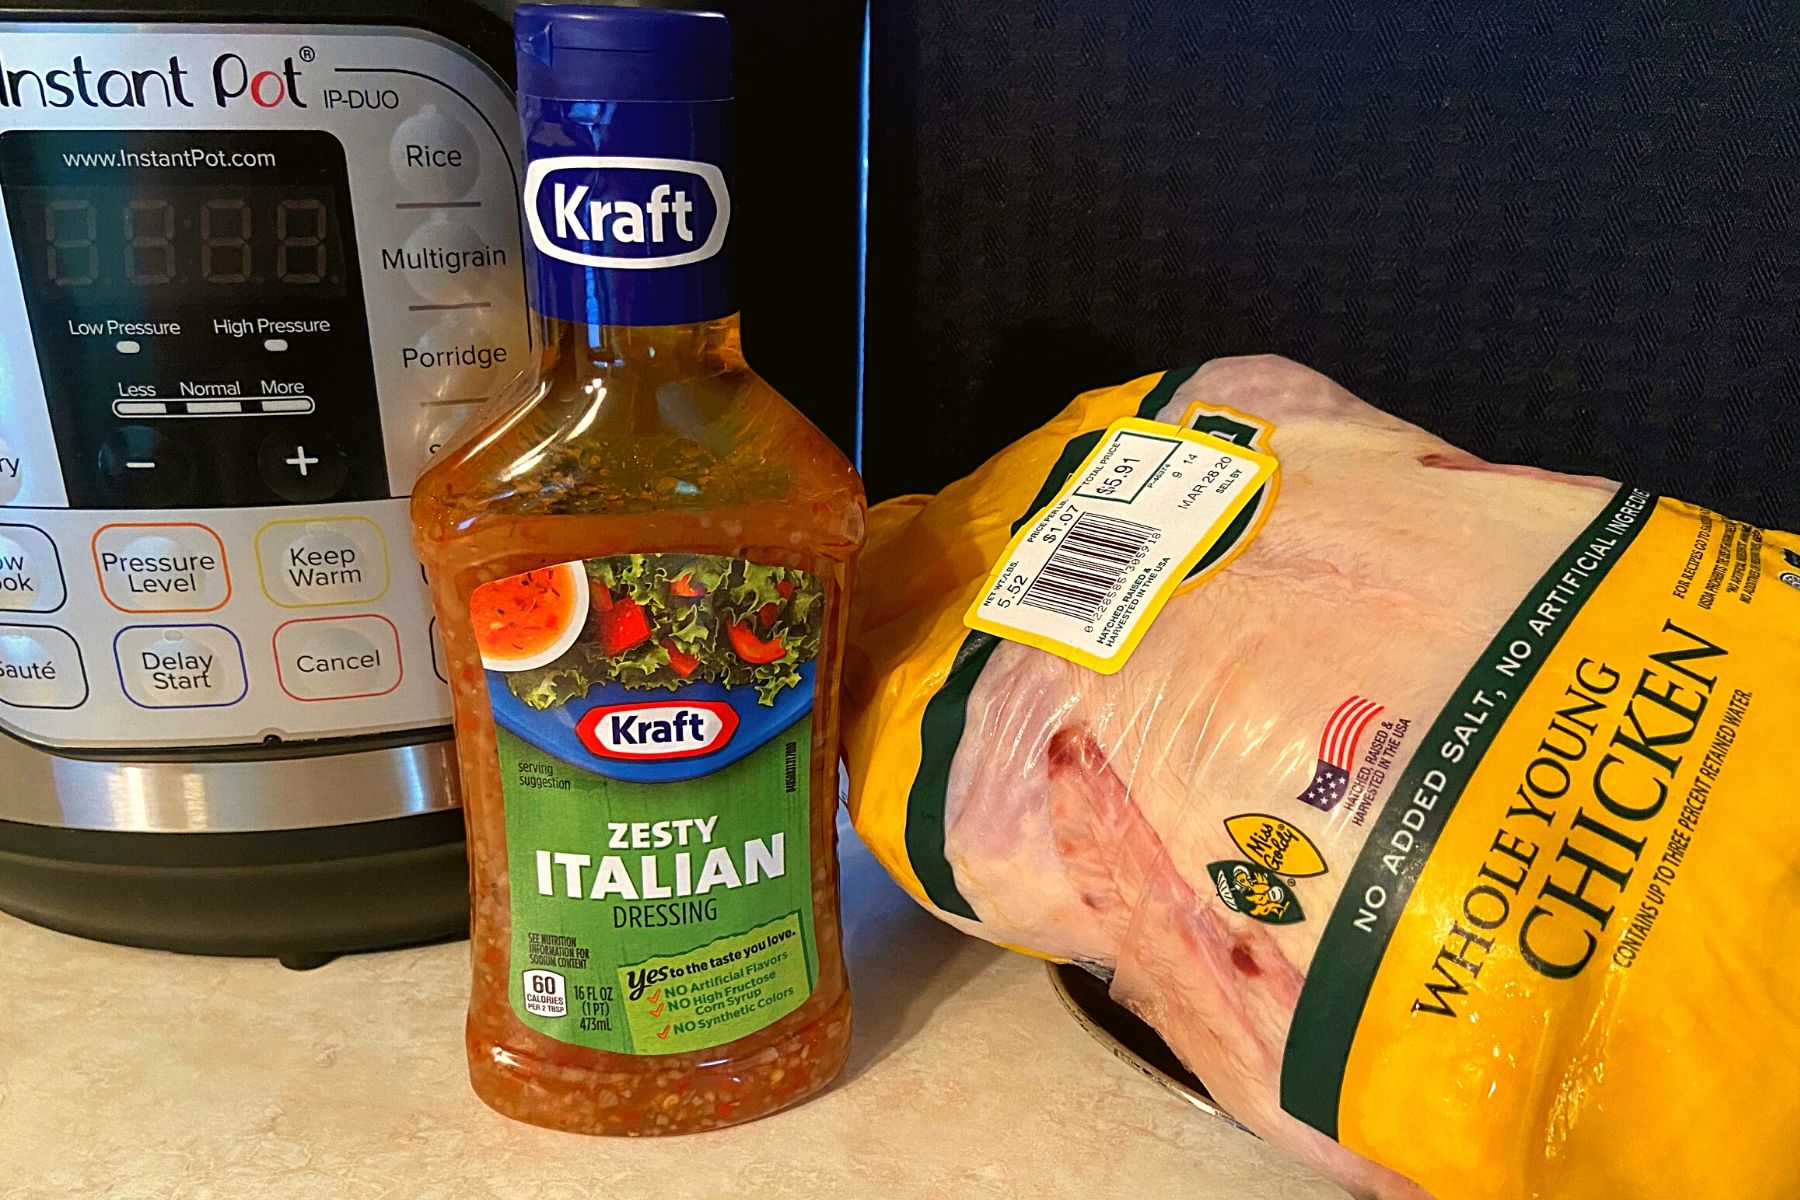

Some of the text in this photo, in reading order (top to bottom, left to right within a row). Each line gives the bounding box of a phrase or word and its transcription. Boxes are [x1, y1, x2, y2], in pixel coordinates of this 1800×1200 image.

[0, 53, 307, 109] Instant Pot
[323, 90, 399, 109] IP-DUO
[63, 149, 276, 169] www.InstantPot.com
[406, 145, 463, 168] Rice
[554, 183, 694, 243] Kraft
[381, 247, 507, 273] Multigrain
[69, 319, 181, 336] Low Pressure
[213, 317, 331, 337] High Pressure
[402, 345, 508, 369] Porridge
[118, 381, 156, 398] Less
[180, 381, 241, 397] Normal
[261, 379, 305, 395] More
[1081, 442, 1121, 486] TOTAL PRICE
[1183, 453, 1199, 466] 14
[1096, 457, 1141, 495] $5.91
[1178, 484, 1208, 510] MAR
[1202, 470, 1220, 484] 28
[1214, 456, 1233, 470] 20
[1216, 468, 1243, 494] SELL BY
[1027, 520, 1047, 543] PRICE
[1043, 508, 1059, 523] PER
[1042, 504, 1079, 544] $1.07
[102, 552, 216, 574] Pressure
[290, 546, 356, 567] Keep
[1673, 580, 1690, 599] FOR
[1682, 549, 1703, 581] RECIPES
[1694, 539, 1708, 551] GO
[129, 574, 197, 594] Level
[288, 568, 362, 588] Warm
[983, 590, 997, 607] NET
[997, 575, 1028, 609] 5.52
[1106, 557, 1171, 647] HARVESTED IN THE USA
[1698, 592, 1714, 609] USDA
[1097, 567, 1152, 644] HATCHED, RAISED &
[142, 651, 214, 673] Delay
[297, 650, 381, 673] Cancel
[153, 671, 212, 690] Start
[1353, 488, 1650, 932] NO ADDED SALT, NO ARTIFICIAL INGREDIE
[611, 710, 704, 745] Kraft
[518, 762, 553, 776] serving
[1344, 722, 1393, 810] HATCHED, RAISED &
[1352, 719, 1411, 826] HARVESTED IN THE USA
[519, 775, 571, 790] suggestion
[1517, 618, 1730, 980] CHICKEN
[607, 815, 718, 849] ZESTY
[1247, 823, 1274, 857] Miss
[1410, 657, 1621, 1020] WHOLE YOUNG
[1613, 688, 1753, 968] CONTAINS UP TO THREE PERCENT RETAINED WATER.
[1263, 827, 1300, 870] Goldy
[536, 832, 785, 900] ITALIAN
[613, 898, 717, 929] DRESSING
[528, 932, 577, 947] SEE NUTRITION
[529, 944, 590, 959] INFORMATION FOR
[557, 958, 587, 969] CONTENT
[670, 967, 685, 979] to
[685, 961, 708, 975] the
[709, 950, 742, 969] taste
[743, 941, 766, 959] you
[767, 928, 796, 948] love.
[532, 975, 556, 994] 60
[664, 951, 788, 999] NO Artificial Flavors
[527, 994, 564, 1005] CALORIES
[574, 986, 613, 1001] 16 FL OZ
[667, 970, 776, 1012] NO High Fructose
[695, 989, 762, 1016] Corn Syrup
[528, 1003, 541, 1011] PER
[593, 1002, 610, 1016] PT)
[673, 986, 794, 1035] NO Synthetic Colors
[580, 1017, 612, 1031] 473mL
